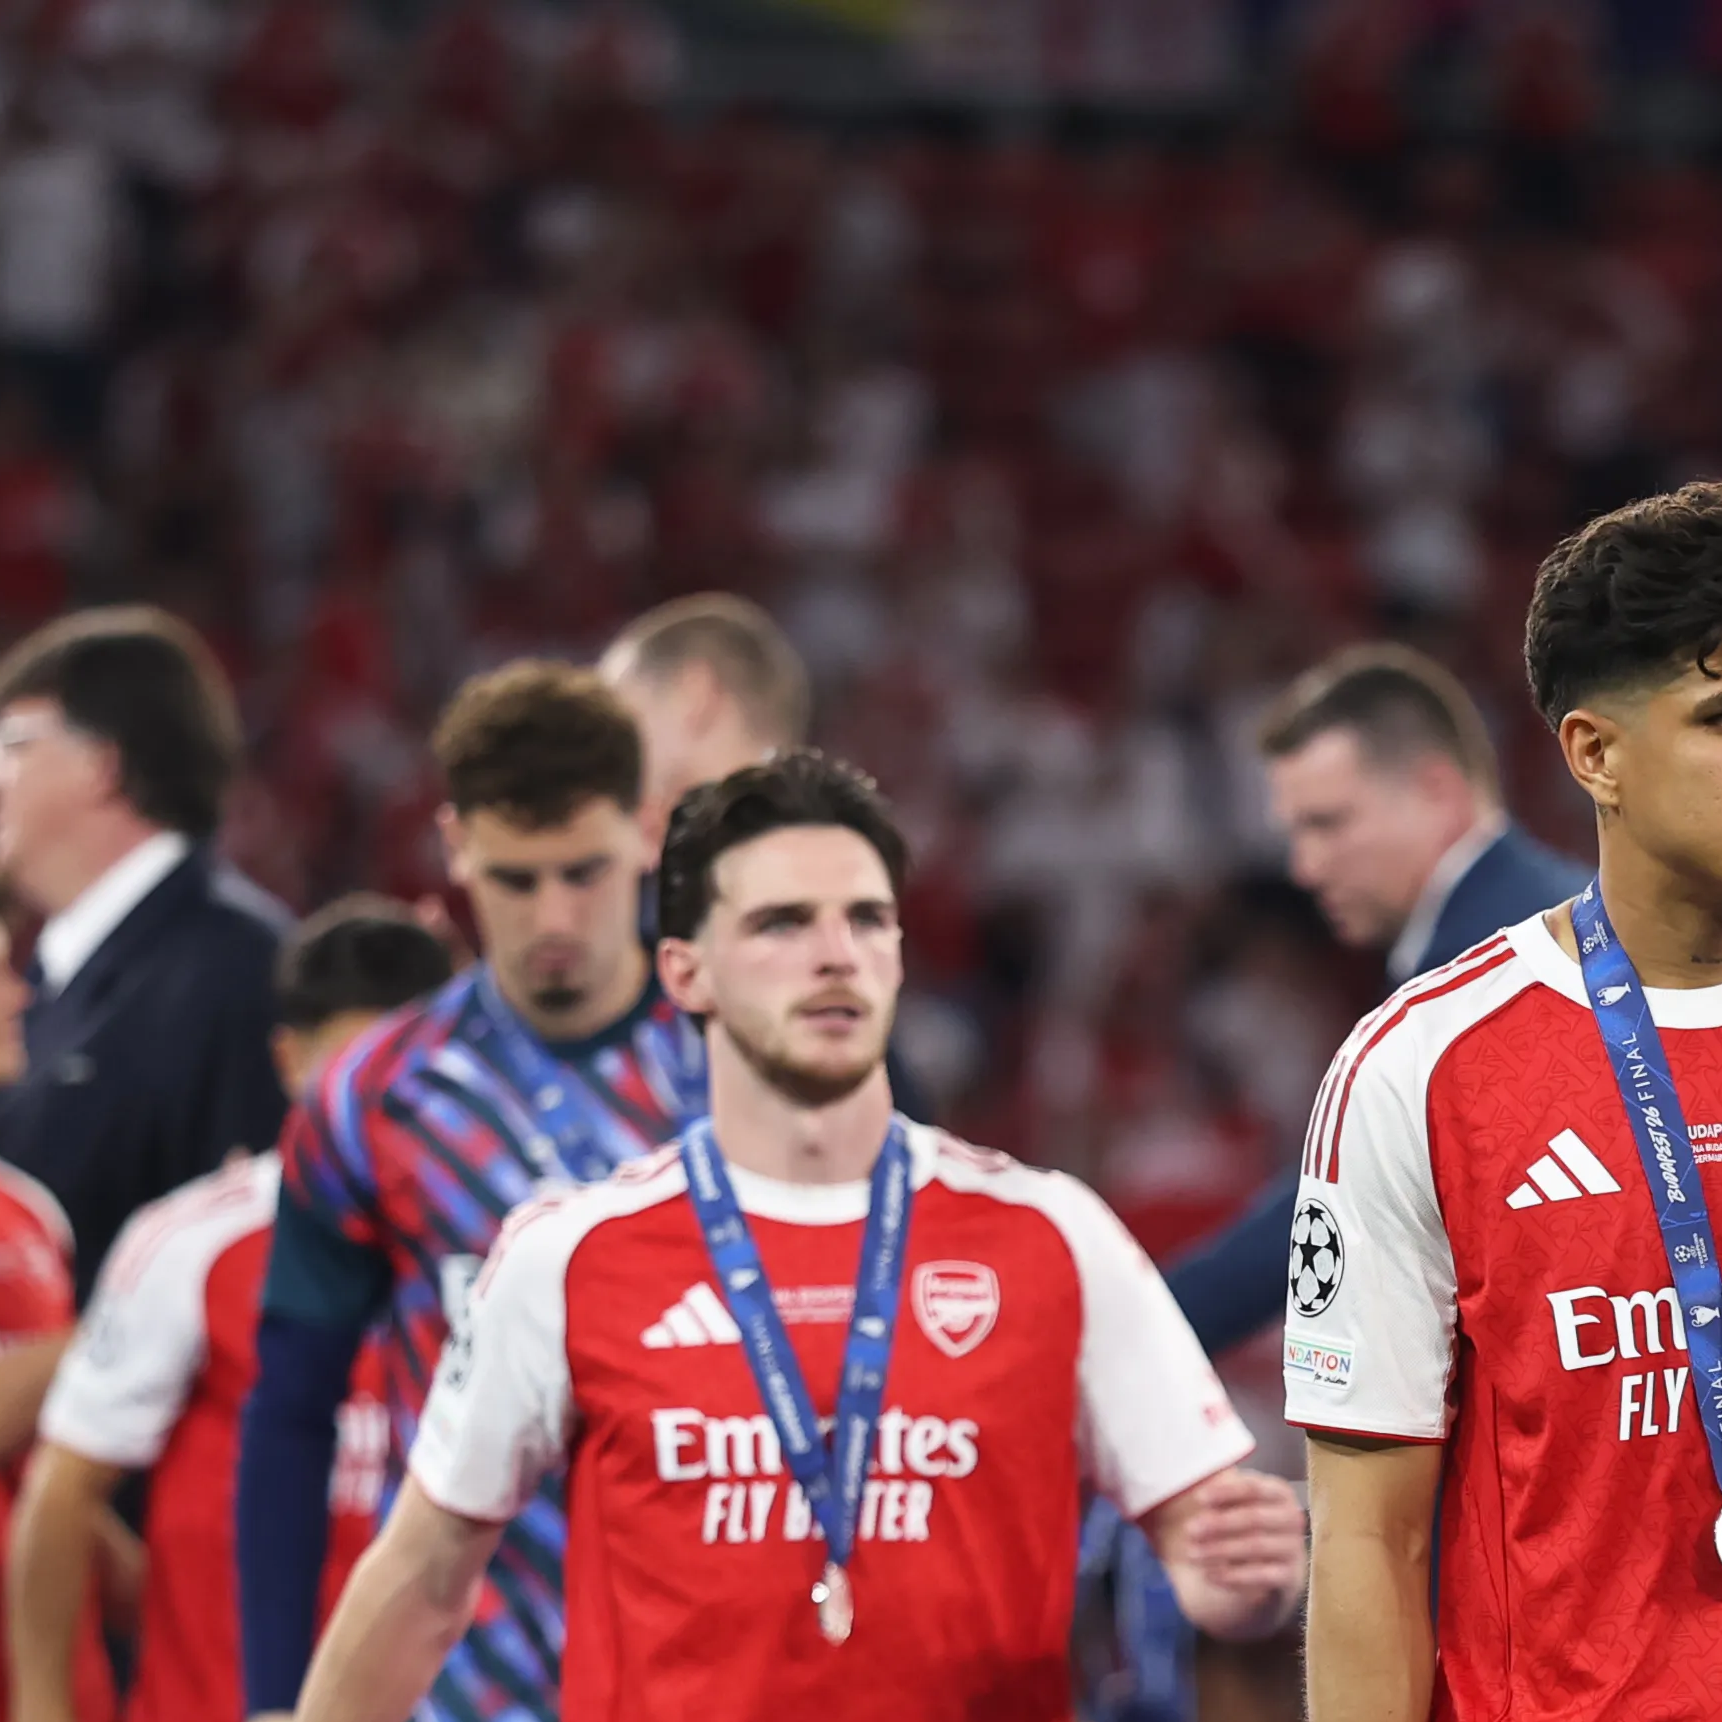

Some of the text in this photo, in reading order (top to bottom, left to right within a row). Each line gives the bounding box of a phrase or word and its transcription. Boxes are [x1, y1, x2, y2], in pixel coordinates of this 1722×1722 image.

[1622, 1032, 1655, 1101] FINAL
[1642, 1106, 1664, 1128] 26
[1619, 1366, 1689, 1441] FLY
[651, 1406, 979, 1482] Emtes
[702, 1479, 933, 1544] FLY BTER
